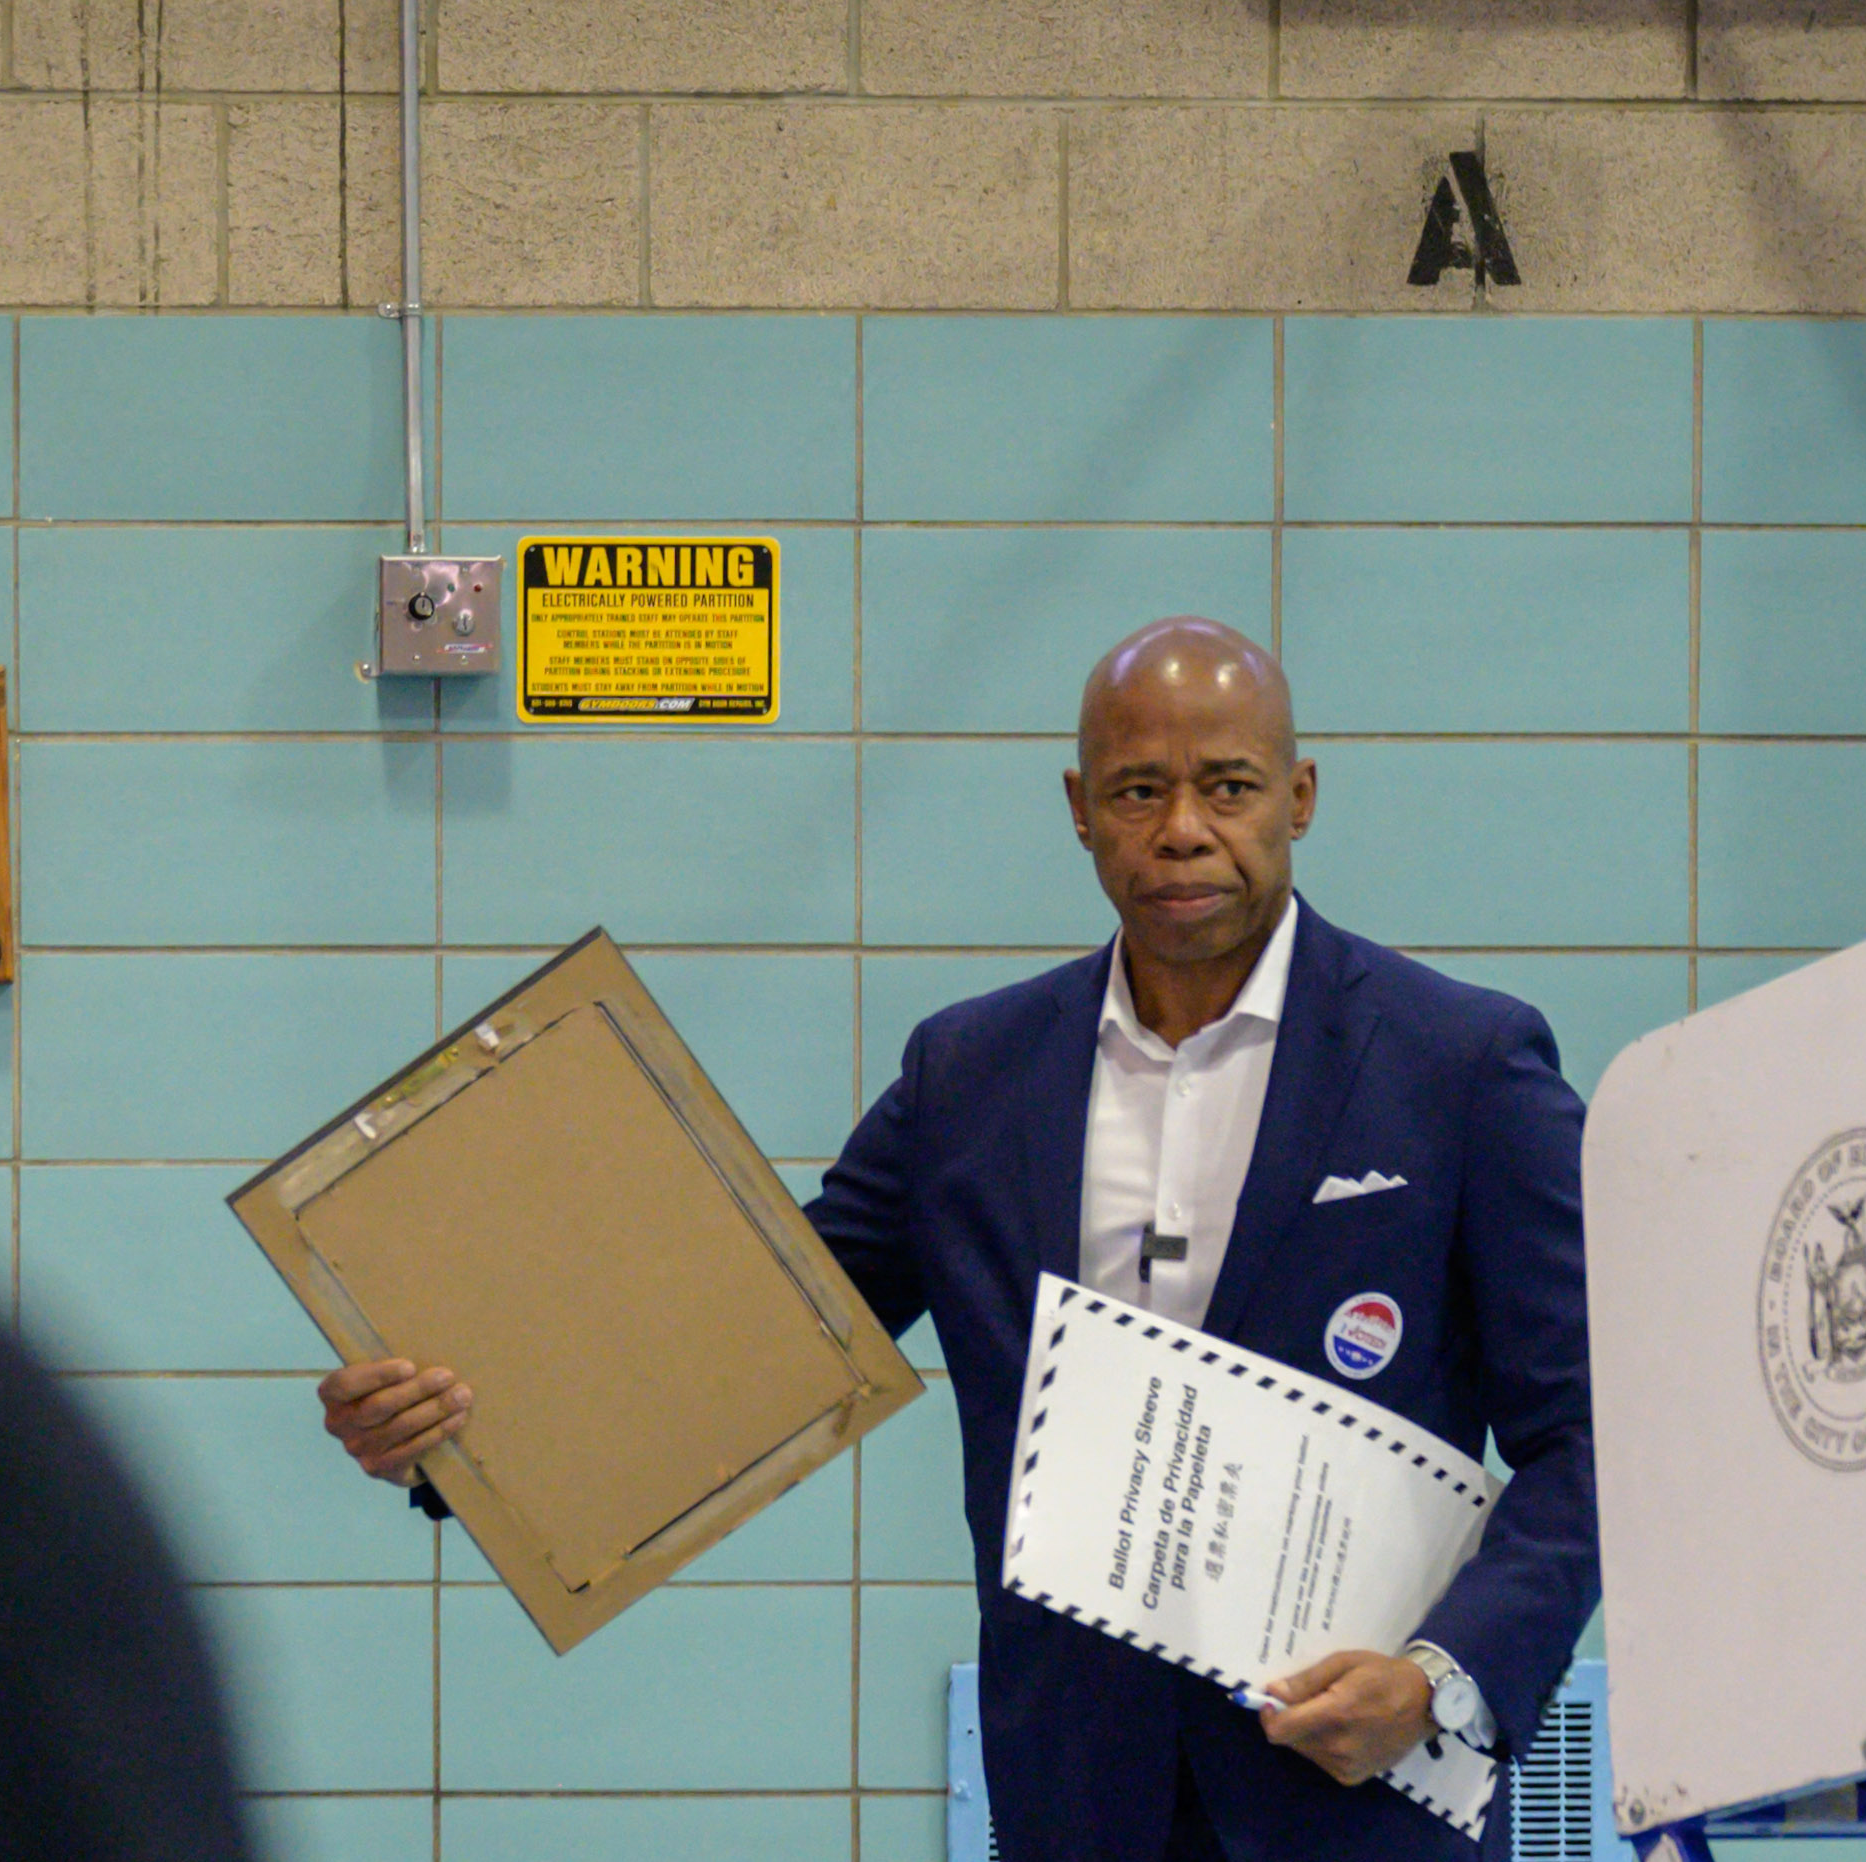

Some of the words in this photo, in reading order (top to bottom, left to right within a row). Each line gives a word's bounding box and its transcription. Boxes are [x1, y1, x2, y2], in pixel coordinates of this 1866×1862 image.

[1407, 152, 1521, 285] A
[542, 546, 754, 587] WARNING
[531, 614, 548, 622] ONLY
[551, 614, 603, 622] APPROPRIATELY
[607, 614, 635, 622] TRAINED
[638, 614, 658, 622] STAFF
[662, 614, 676, 622] MAY
[679, 614, 708, 622] OPERATE
[712, 614, 727, 622] THIS
[730, 614, 765, 622] PARTITION
[542, 594, 625, 608] ELECTRICALLY
[631, 594, 688, 608] POWERED
[694, 594, 754, 608] PARTITION
[557, 630, 589, 638] CONTROL
[593, 630, 626, 638] STATIONS
[630, 630, 649, 638] MUST
[652, 630, 661, 638] BE
[665, 630, 702, 638] ATTENDED
[705, 630, 714, 638] BY
[717, 630, 738, 638] STAFF
[564, 640, 600, 648] MEMBERS
[604, 640, 624, 648] WHILE
[629, 640, 640, 648] THE
[645, 640, 680, 648] PARTITION
[684, 640, 691, 648] IS
[695, 640, 702, 648] IN
[705, 640, 732, 648] MOTION
[544, 667, 581, 676] PARTITION
[584, 667, 610, 676] DURING
[614, 667, 649, 676] STACKING
[652, 667, 662, 676] OR
[665, 667, 706, 676] EXTENDING
[708, 667, 750, 676] PROCEDURE
[550, 656, 570, 665] STAFF
[574, 656, 610, 665] MEMBERS
[614, 656, 633, 665] MUST
[637, 656, 660, 665] STAND
[662, 656, 673, 665] ON
[676, 656, 708, 665] OPPOSITE
[713, 656, 734, 665] SIDES
[738, 656, 746, 665] OF
[532, 683, 568, 692] STUDENTS
[572, 683, 591, 692] MUST
[595, 683, 612, 692] STAY
[615, 683, 634, 692] AWAY
[638, 683, 658, 692] FROM
[661, 683, 698, 692] PARTITION
[701, 683, 722, 692] WHILE
[726, 683, 734, 692] IN
[737, 683, 764, 692] MOTION
[1768, 1177, 1815, 1283] BOARD
[1817, 1149, 1842, 1183] OF
[1134, 1376, 1162, 1445] Sleeve
[1163, 1383, 1197, 1493] Privacidad
[1803, 1416, 1848, 1454] CITY
[1119, 1448, 1151, 1526] Privacy
[1181, 1424, 1212, 1513] Papeleta
[1159, 1498, 1175, 1525] de
[1176, 1518, 1194, 1538] la
[1108, 1529, 1132, 1590] Ballot
[1142, 1529, 1170, 1610] Carpeta
[1170, 1541, 1189, 1591] para
